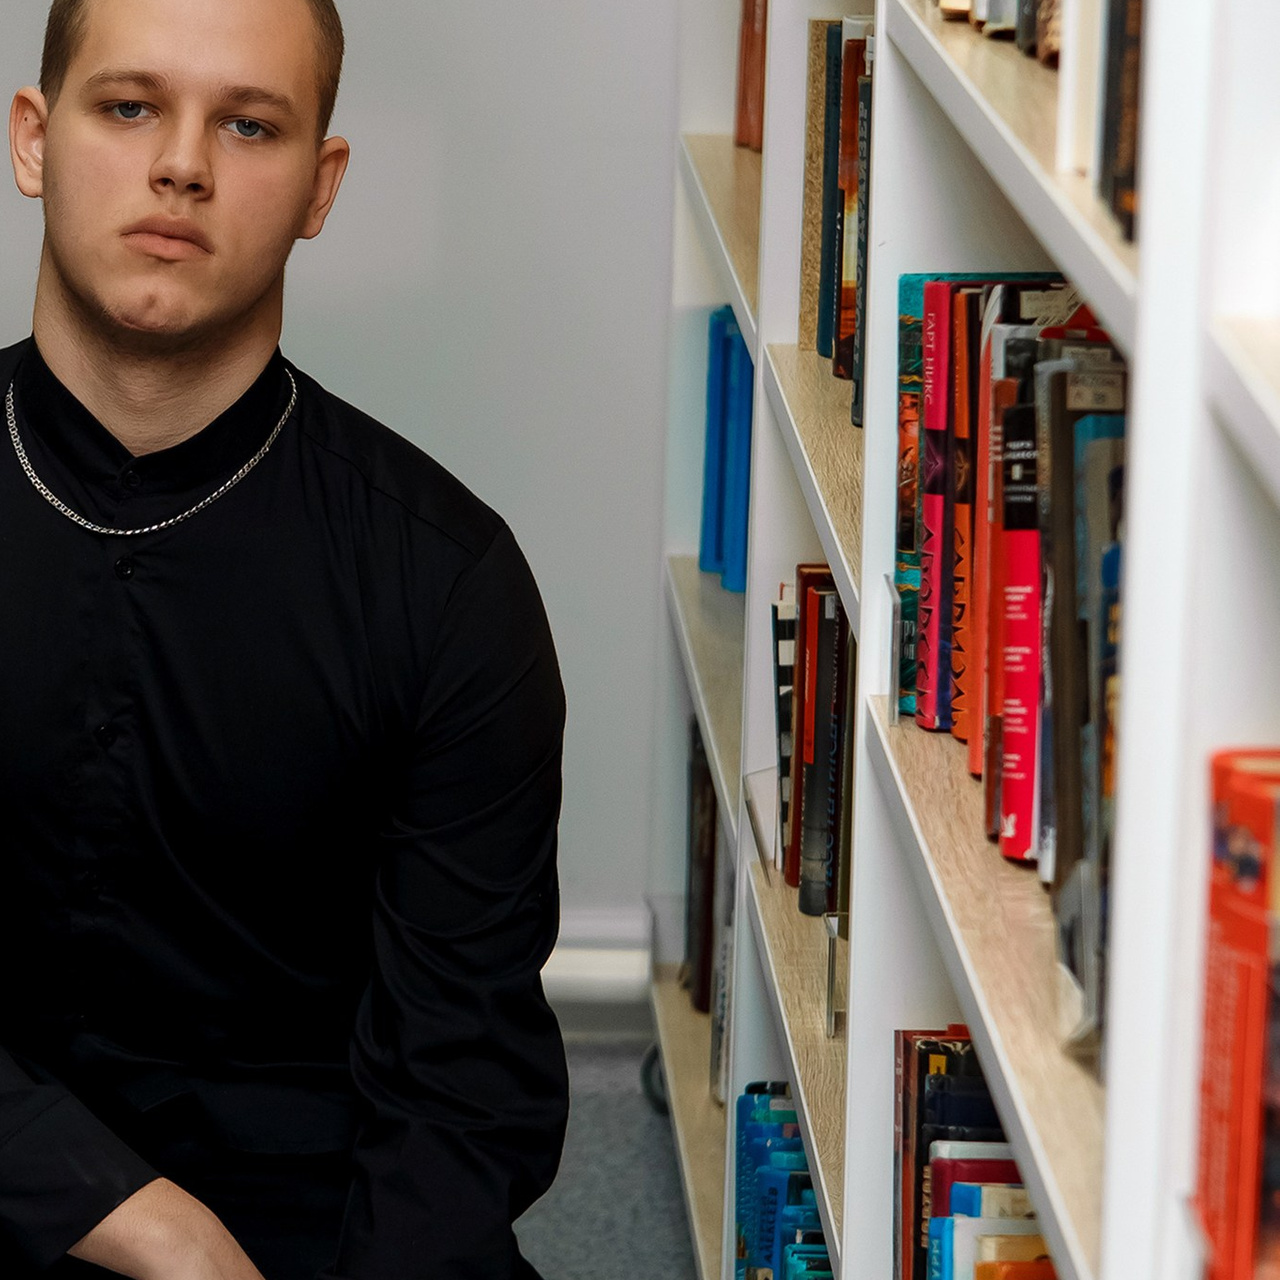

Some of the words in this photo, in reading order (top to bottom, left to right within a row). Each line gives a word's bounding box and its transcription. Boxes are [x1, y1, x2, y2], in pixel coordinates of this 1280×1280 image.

[856, 100, 867, 242] ДРАЙЗЕР
[926, 312, 936, 351] ГАРТ
[924, 357, 934, 405] НИКС
